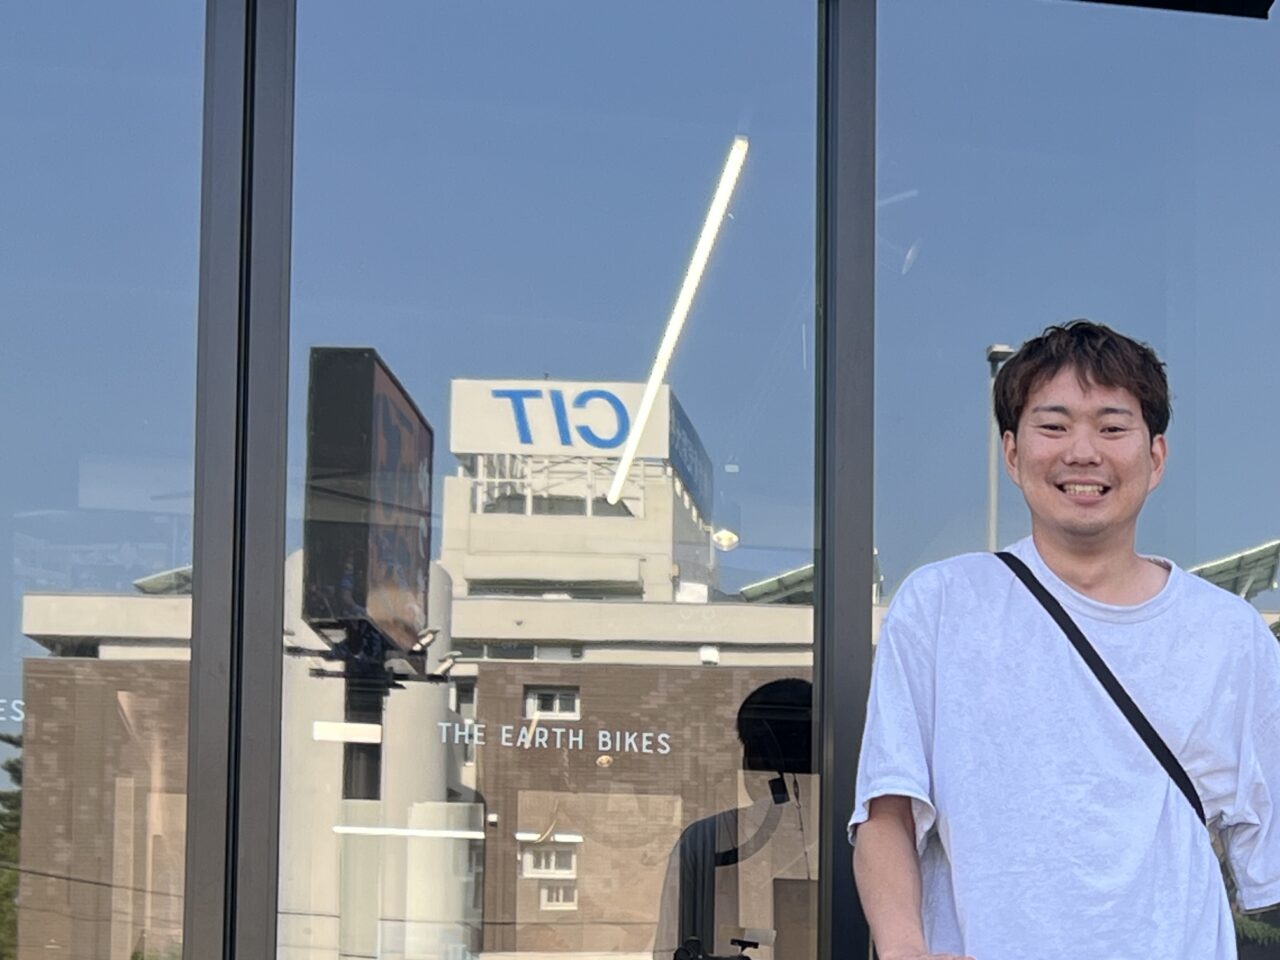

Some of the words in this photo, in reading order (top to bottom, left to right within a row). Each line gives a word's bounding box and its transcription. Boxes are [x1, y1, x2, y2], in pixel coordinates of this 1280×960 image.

[437, 722, 486, 746] THE
[501, 726, 584, 750] EARTH
[598, 730, 671, 754] BIKES
